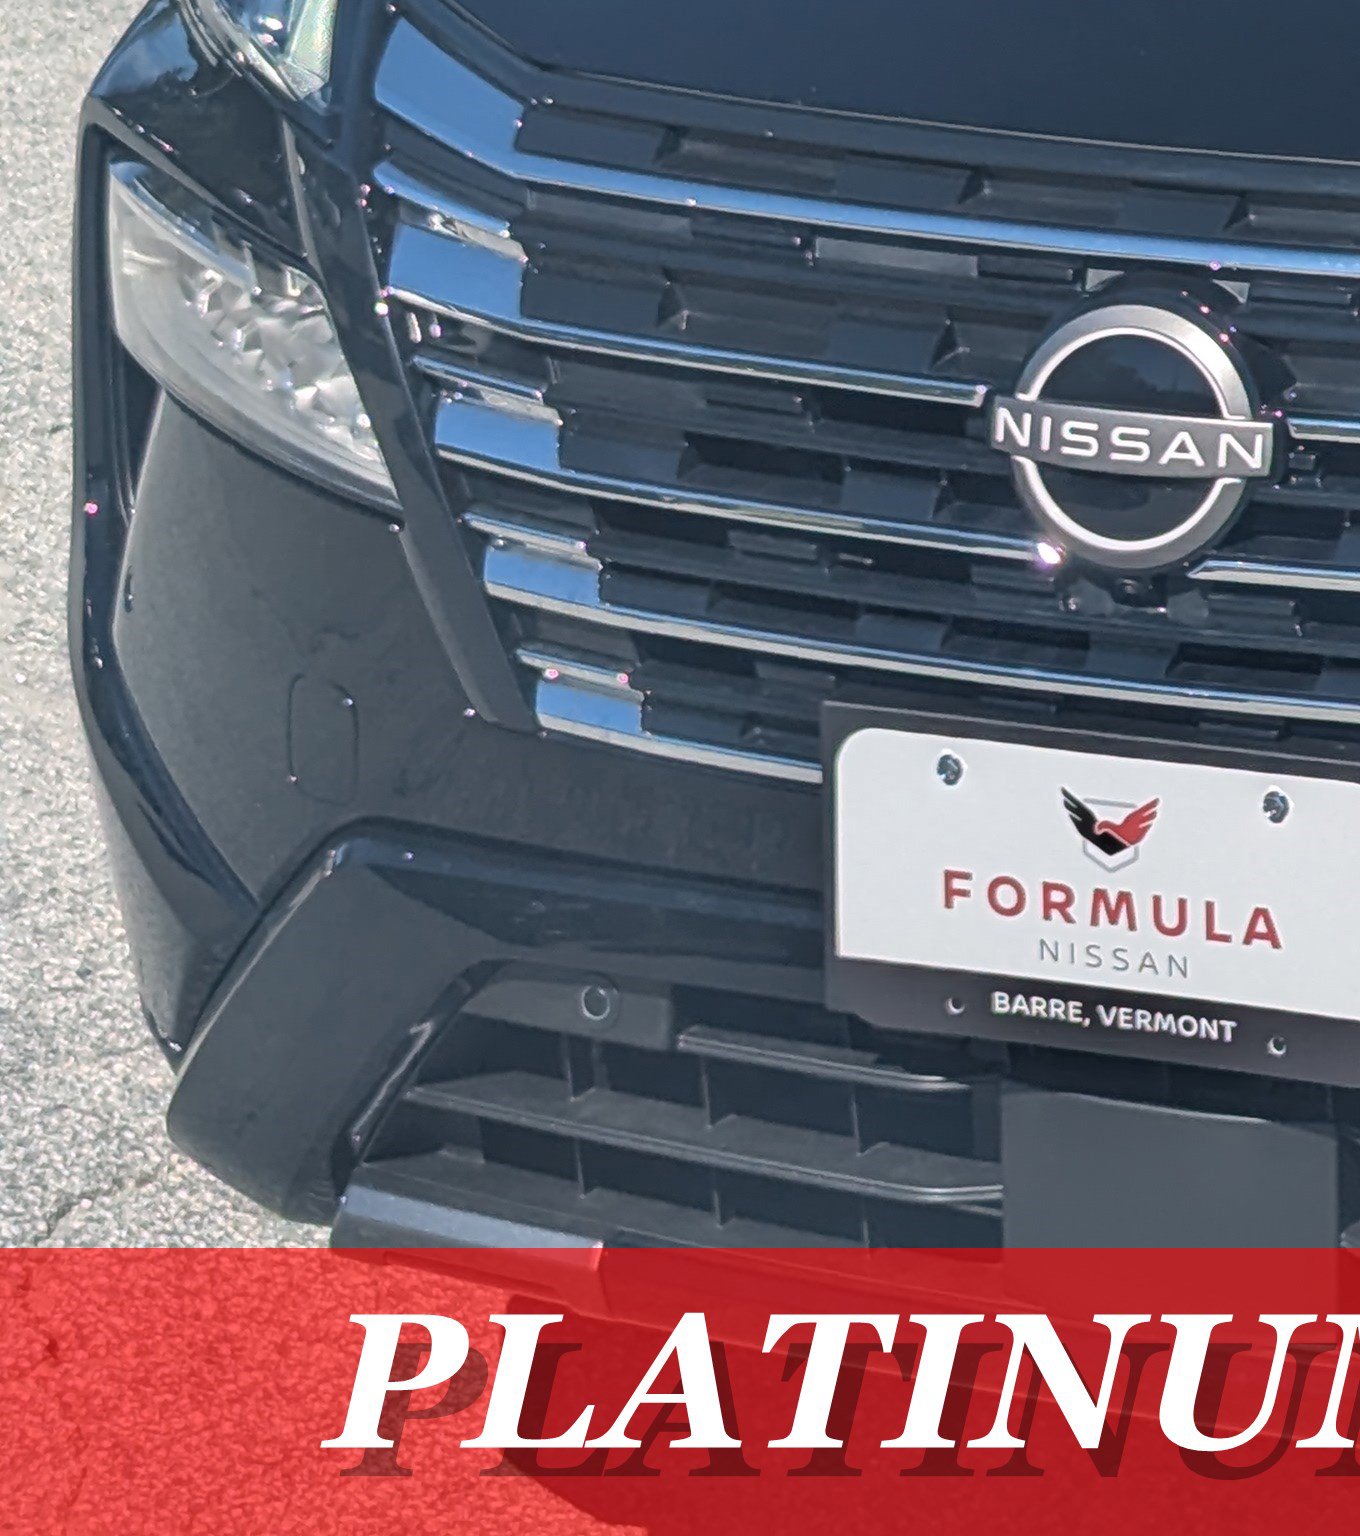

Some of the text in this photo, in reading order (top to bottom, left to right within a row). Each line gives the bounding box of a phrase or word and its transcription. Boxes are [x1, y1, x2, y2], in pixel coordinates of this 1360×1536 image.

[994, 406, 1264, 470] NISSAN
[942, 867, 1283, 951] FORMULA
[1038, 937, 1190, 980] NISSAN
[991, 990, 1238, 1044] BARRE, VERMONT
